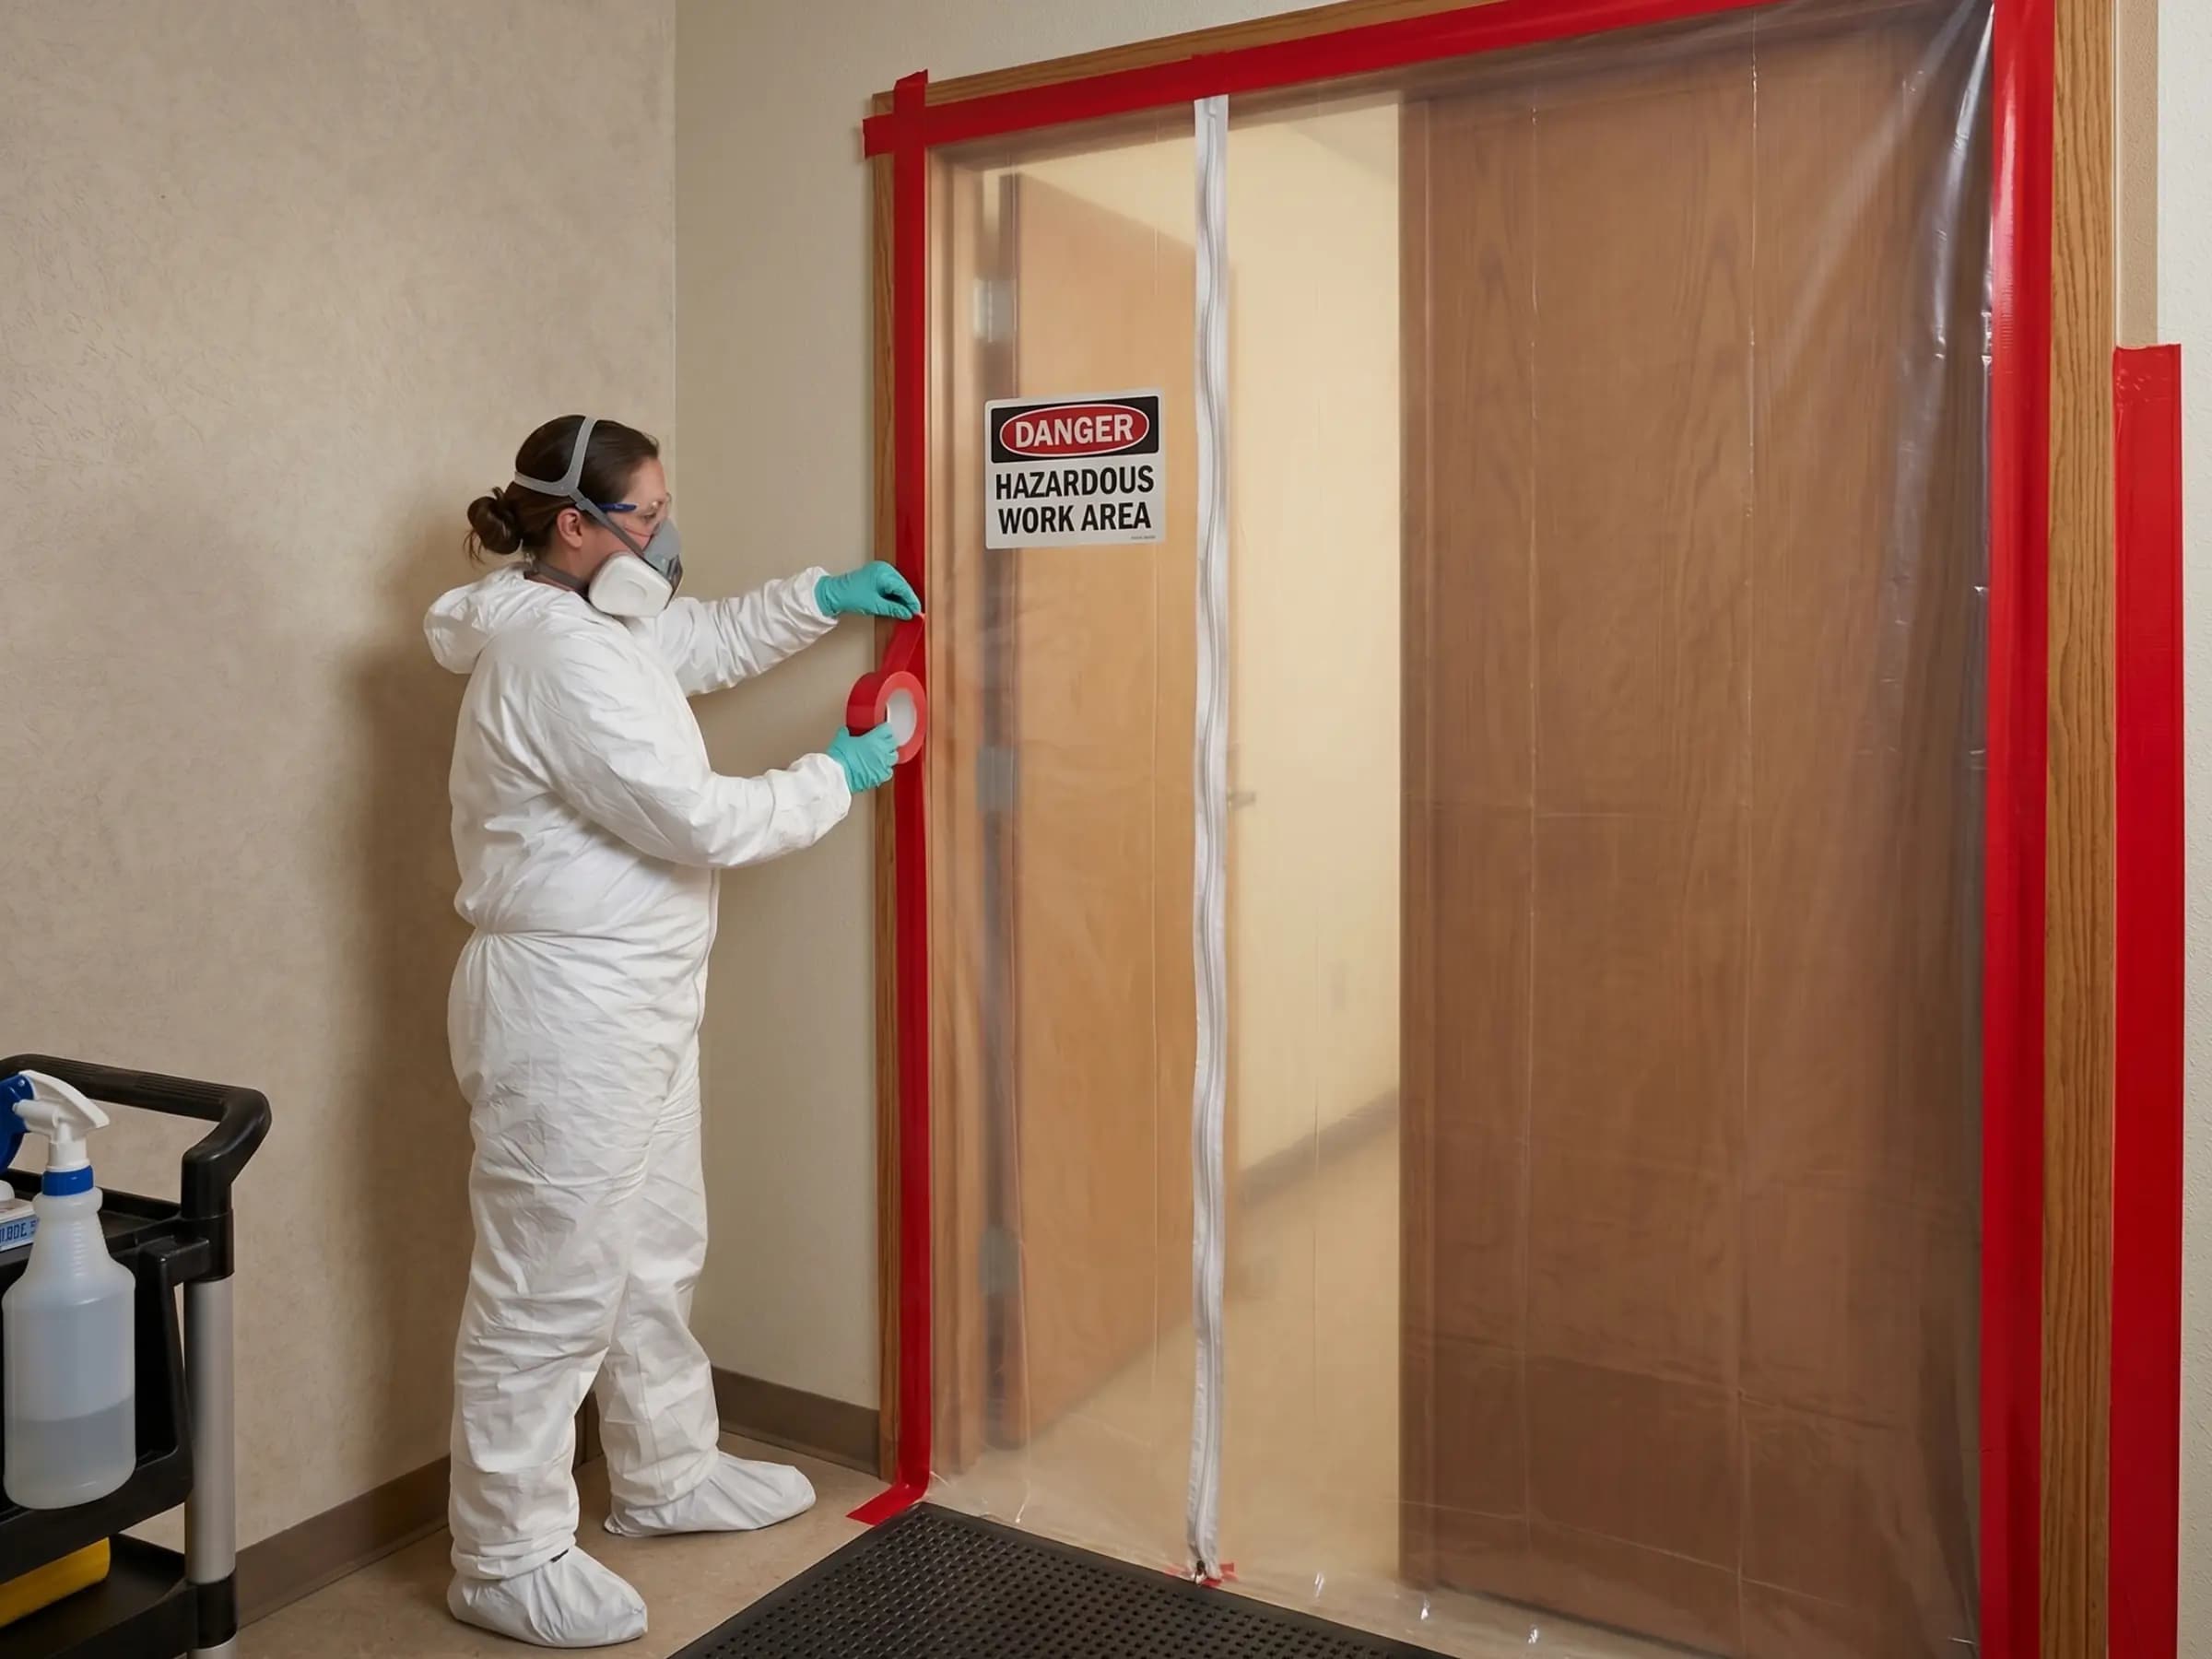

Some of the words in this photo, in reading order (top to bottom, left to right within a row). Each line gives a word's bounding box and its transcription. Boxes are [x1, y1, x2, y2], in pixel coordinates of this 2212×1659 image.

[1016, 414, 1134, 448] DANGER
[995, 465, 1154, 500] HAZARDOUS
[998, 505, 1075, 535] WORK
[1081, 501, 1151, 531] AREA
